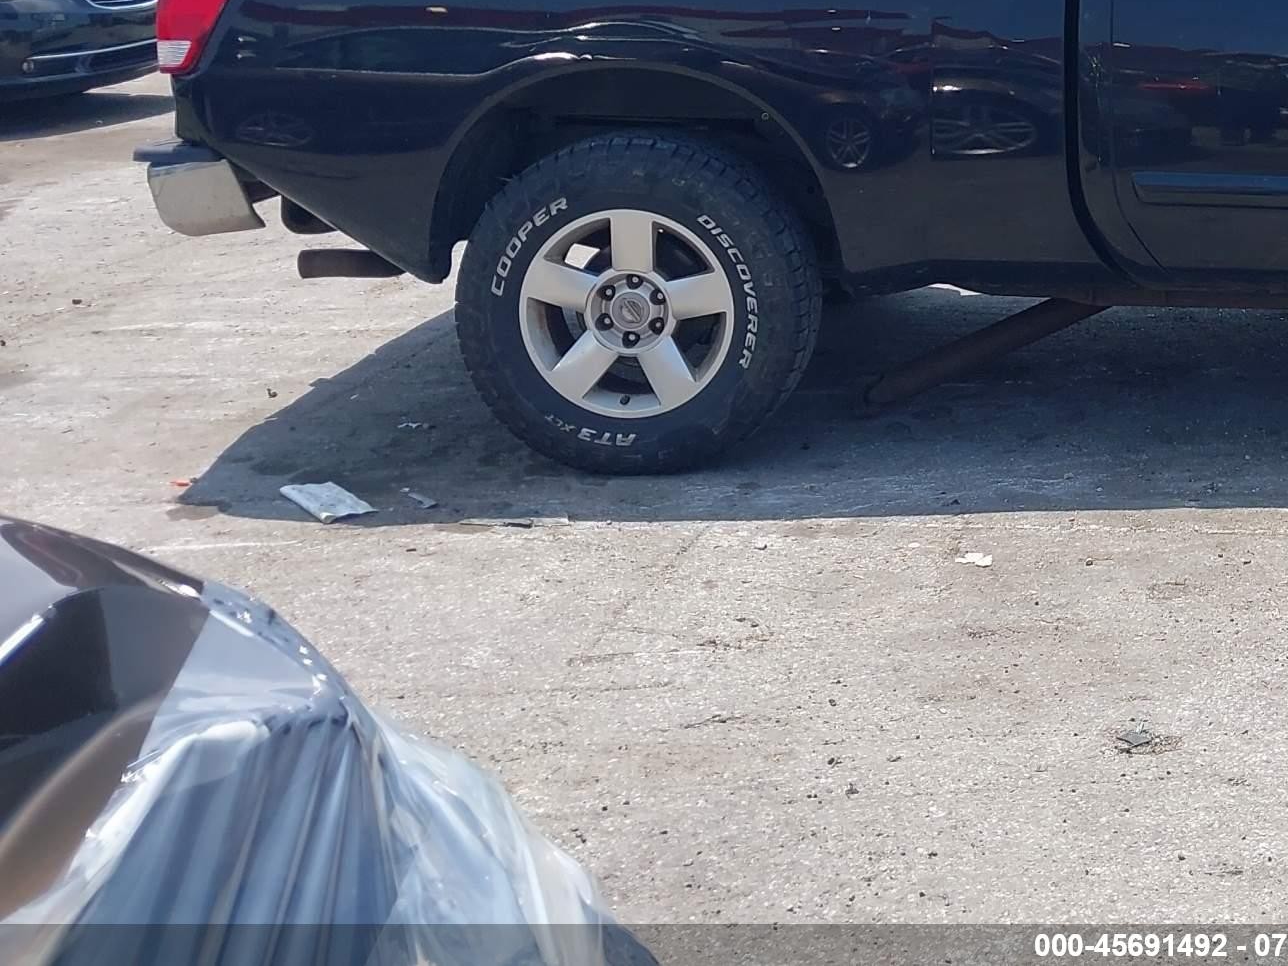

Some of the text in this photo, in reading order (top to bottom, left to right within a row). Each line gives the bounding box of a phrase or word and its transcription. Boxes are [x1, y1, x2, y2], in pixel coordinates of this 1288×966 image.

[491, 197, 568, 298] COOPER
[696, 214, 759, 370] DISCOVERER
[577, 427, 637, 447] AT3
